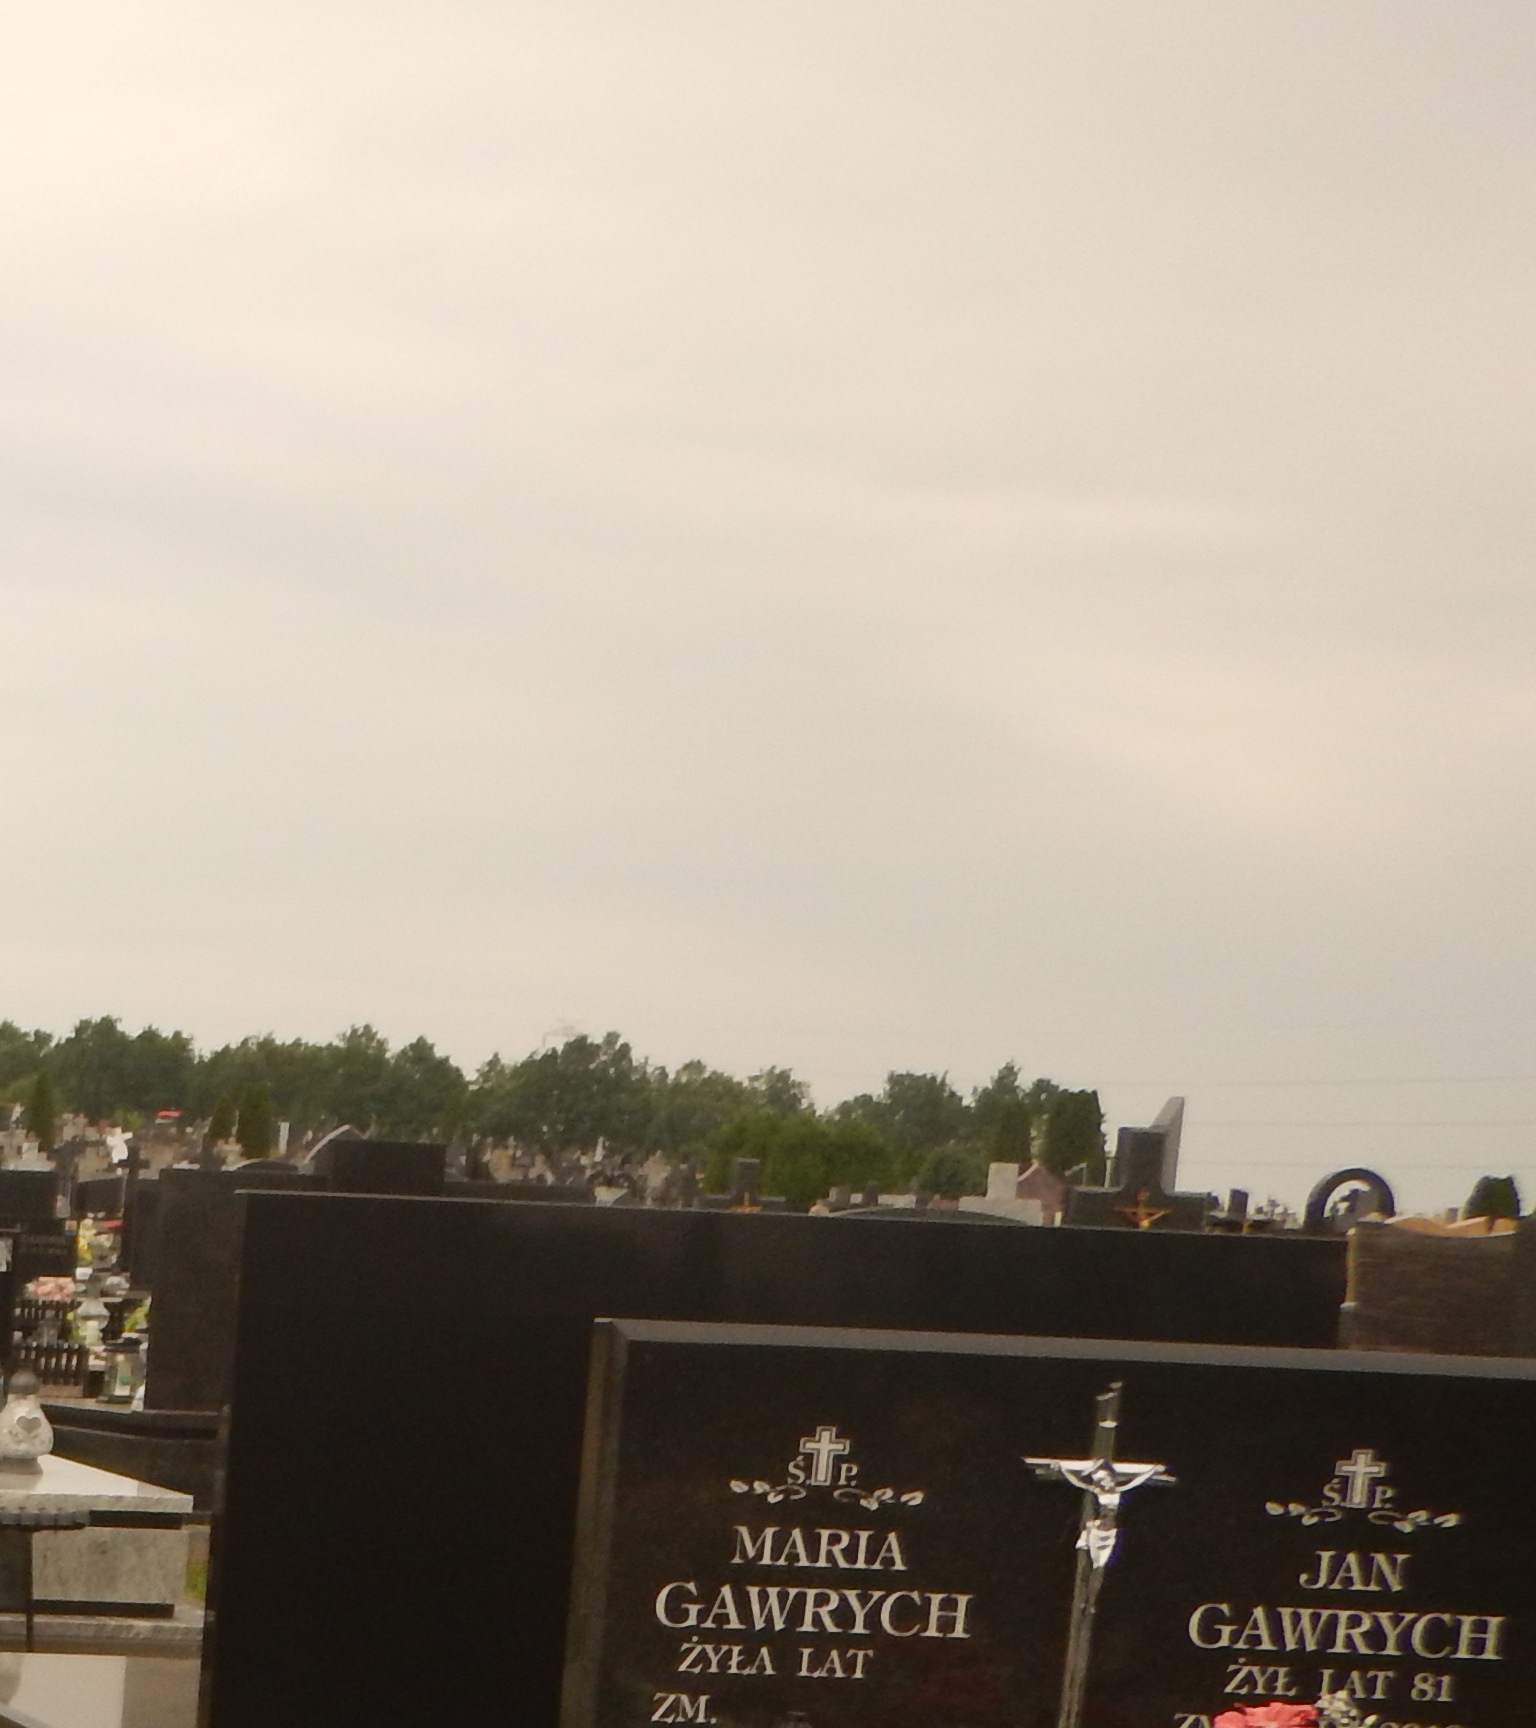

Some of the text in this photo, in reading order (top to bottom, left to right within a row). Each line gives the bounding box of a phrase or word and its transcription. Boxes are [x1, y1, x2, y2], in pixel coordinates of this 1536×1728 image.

[729, 1525, 908, 1572] MARIA
[1298, 1550, 1413, 1592] JAN
[654, 1581, 975, 1639] GAWRYCH
[1188, 1603, 1507, 1660] GAWRYCH
[677, 1635, 875, 1680] ŻYŁA LAT
[1224, 1657, 1456, 1702] ŻYŁ LAT 81
[650, 1692, 718, 1724] ZM.
